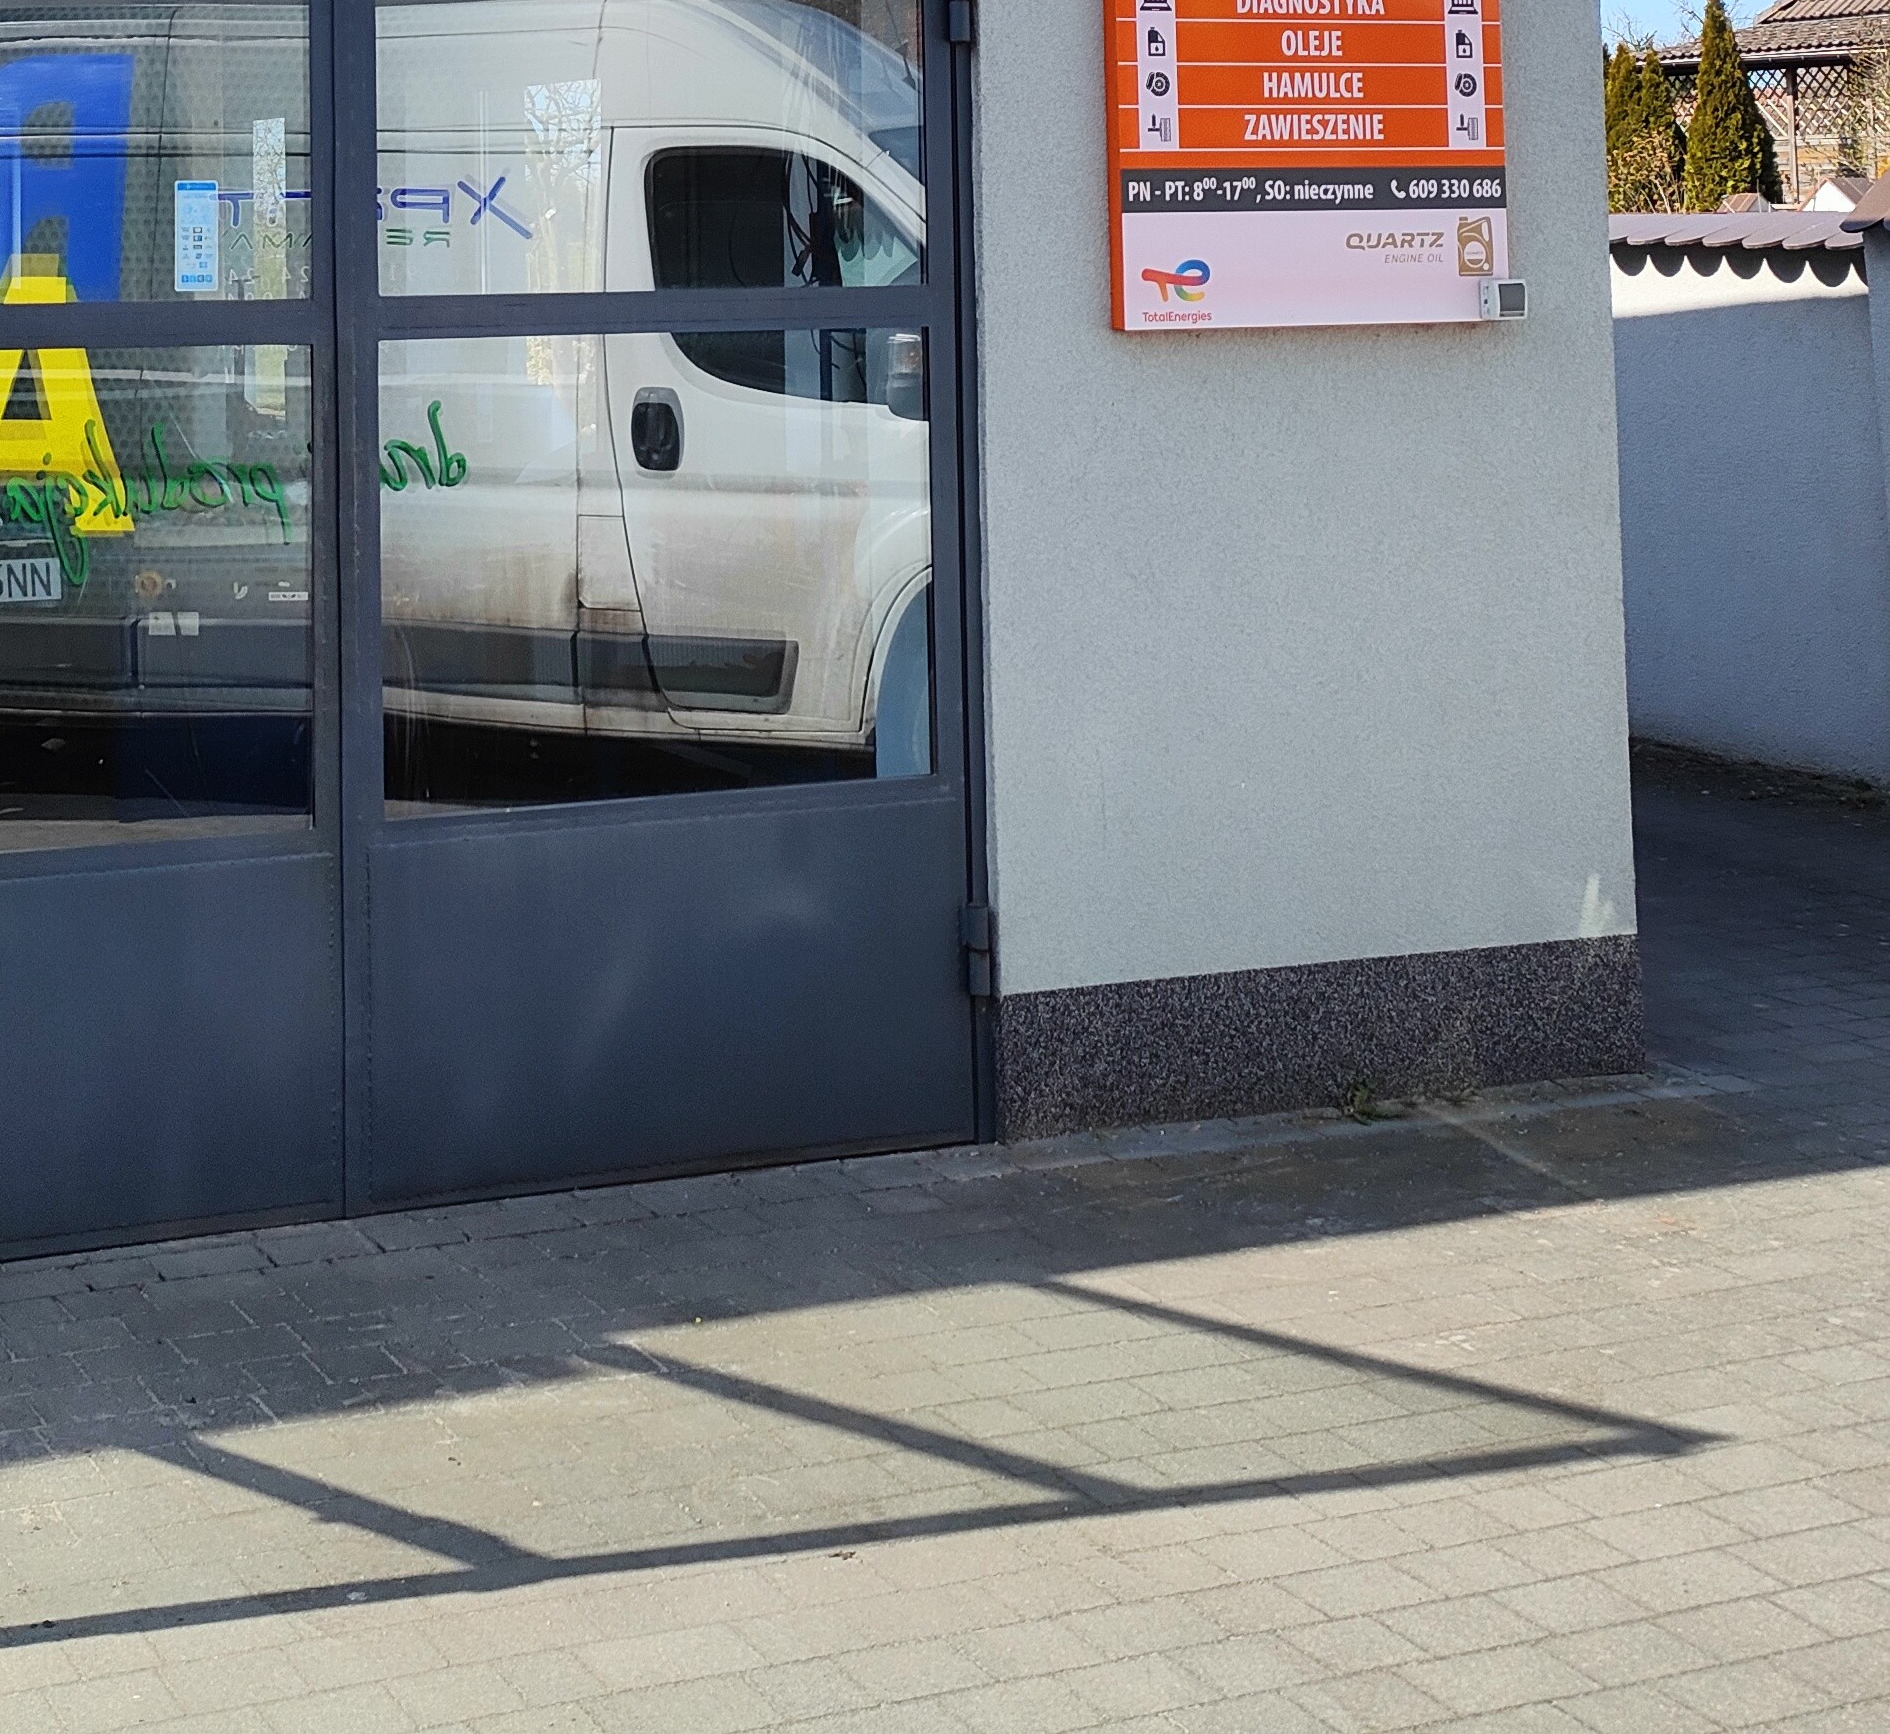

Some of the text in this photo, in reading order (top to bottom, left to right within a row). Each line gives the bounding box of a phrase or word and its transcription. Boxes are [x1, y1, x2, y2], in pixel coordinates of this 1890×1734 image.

[1280, 29, 1343, 57] OLEJE
[1262, 71, 1364, 99] HAMULCE
[1243, 114, 1385, 141] ZAWIESZENIE
[1128, 181, 1151, 202] PN
[1165, 180, 1190, 201] PT:
[1264, 179, 1291, 201] SO:
[1293, 179, 1374, 205] nieczynne
[1409, 178, 1438, 199] 609
[1441, 178, 1470, 199] 330
[1472, 178, 1502, 199] 686
[1345, 231, 1445, 251] QUARTZ
[1384, 253, 1444, 264] ENGINE OIL
[1142, 310, 1213, 324] TotalEnergies
